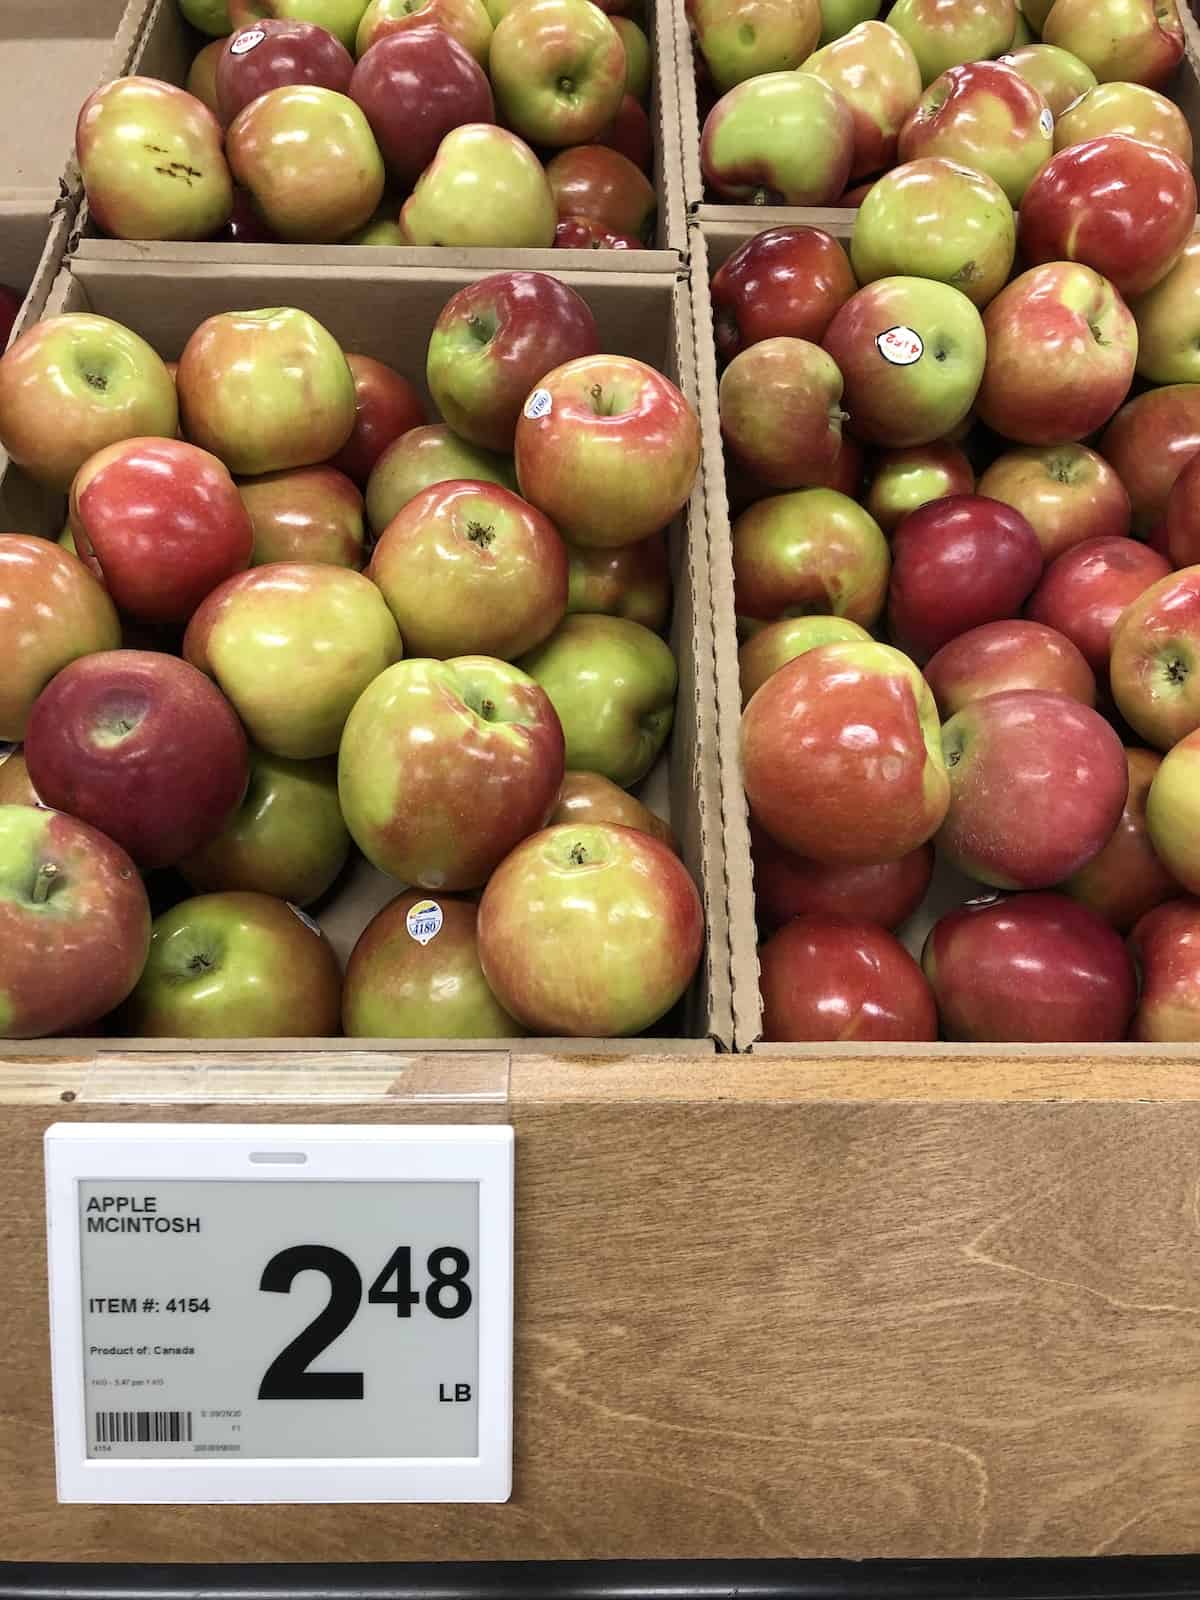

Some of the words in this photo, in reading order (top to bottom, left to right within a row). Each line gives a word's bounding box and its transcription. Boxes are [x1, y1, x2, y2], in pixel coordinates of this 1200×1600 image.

[86, 1196, 157, 1213] APPLE
[86, 1217, 201, 1233] MCINTOSH
[89, 1298, 137, 1313] ITEM
[142, 1298, 160, 1313] #:
[166, 1298, 211, 1313] 4154
[257, 1244, 364, 1401] 2
[367, 1245, 473, 1320] 48
[89, 1345, 134, 1355] Product
[153, 1345, 195, 1355] Canada
[438, 1383, 472, 1402] LB
